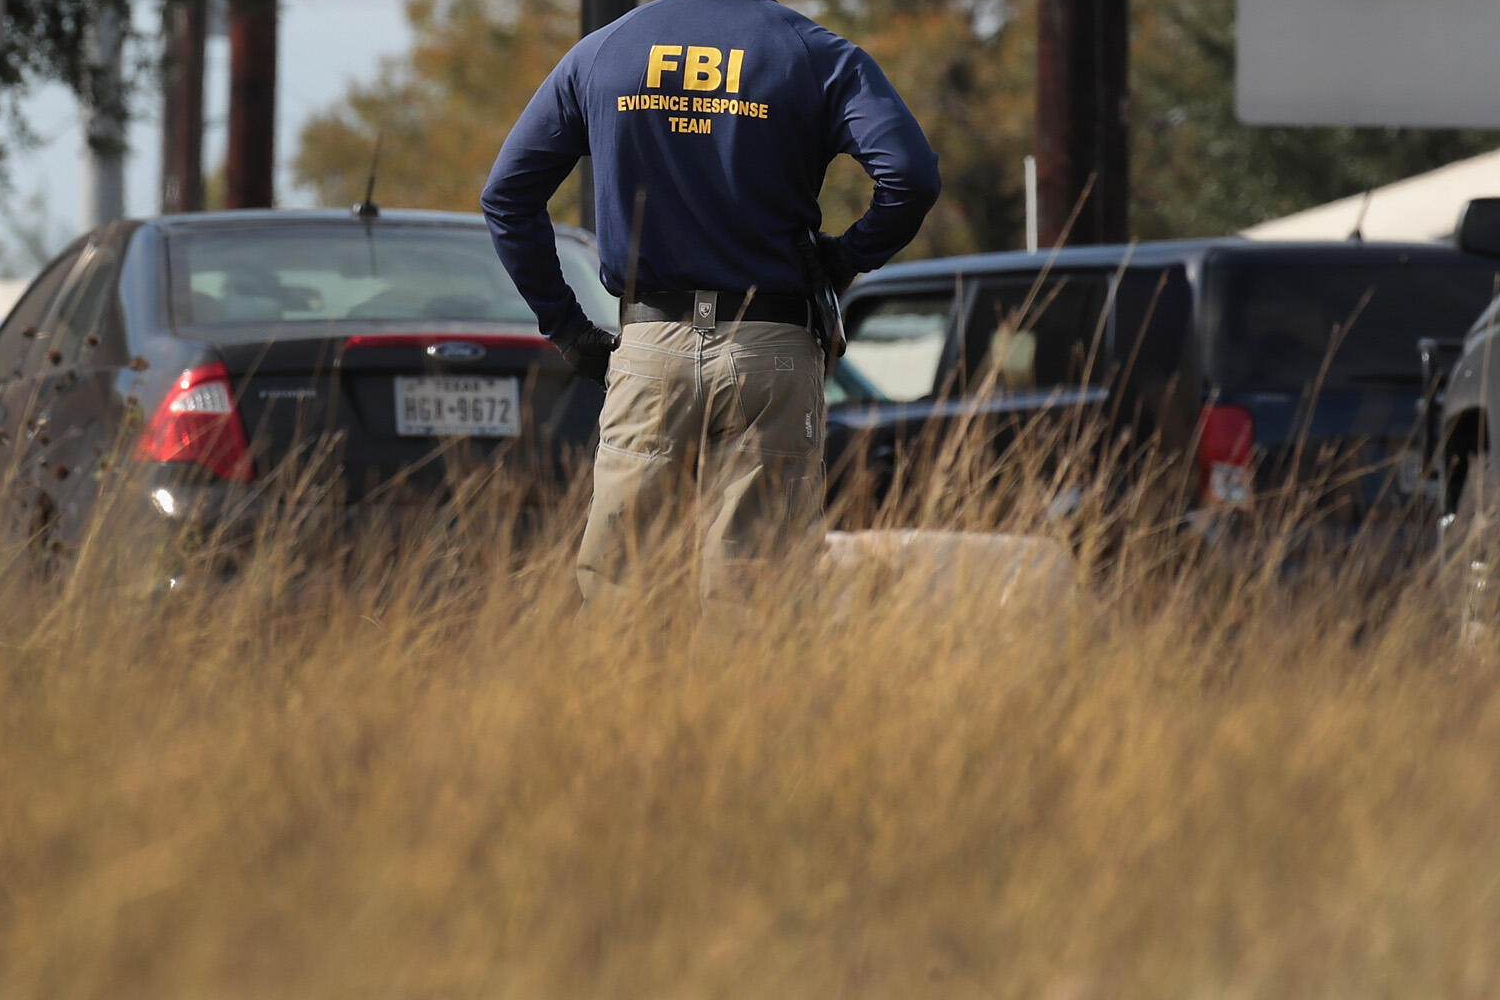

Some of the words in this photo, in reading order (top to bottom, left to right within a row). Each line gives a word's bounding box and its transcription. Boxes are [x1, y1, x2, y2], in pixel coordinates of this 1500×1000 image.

[646, 44, 745, 94] FBI
[617, 94, 689, 112] EVIDENCE
[692, 97, 769, 119] RESPONSE
[668, 117, 712, 134] TEAM
